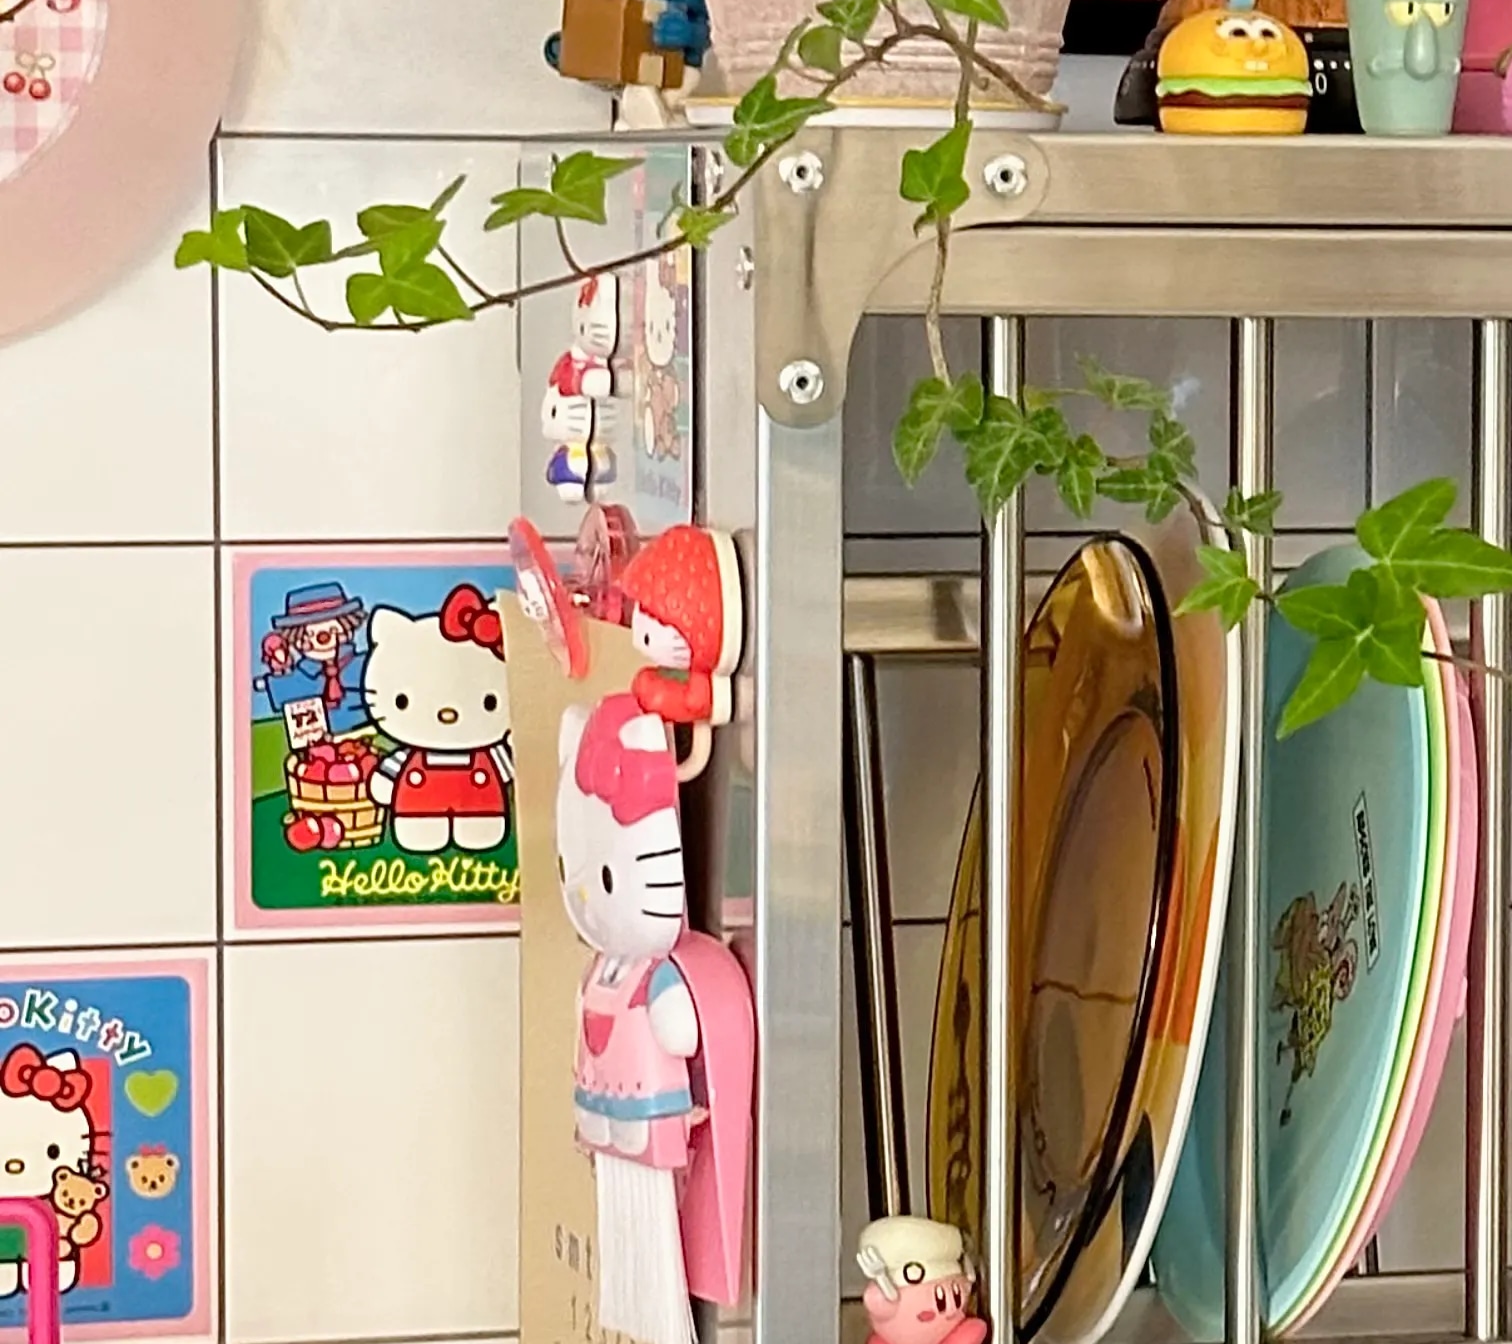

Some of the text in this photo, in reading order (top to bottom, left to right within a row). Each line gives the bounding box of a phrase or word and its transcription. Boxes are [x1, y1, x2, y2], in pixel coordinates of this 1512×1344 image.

[319, 856, 520, 903] Hello Kitty
[20, 987, 153, 1067] Kitty
[584, 1302, 593, 1342] 2
